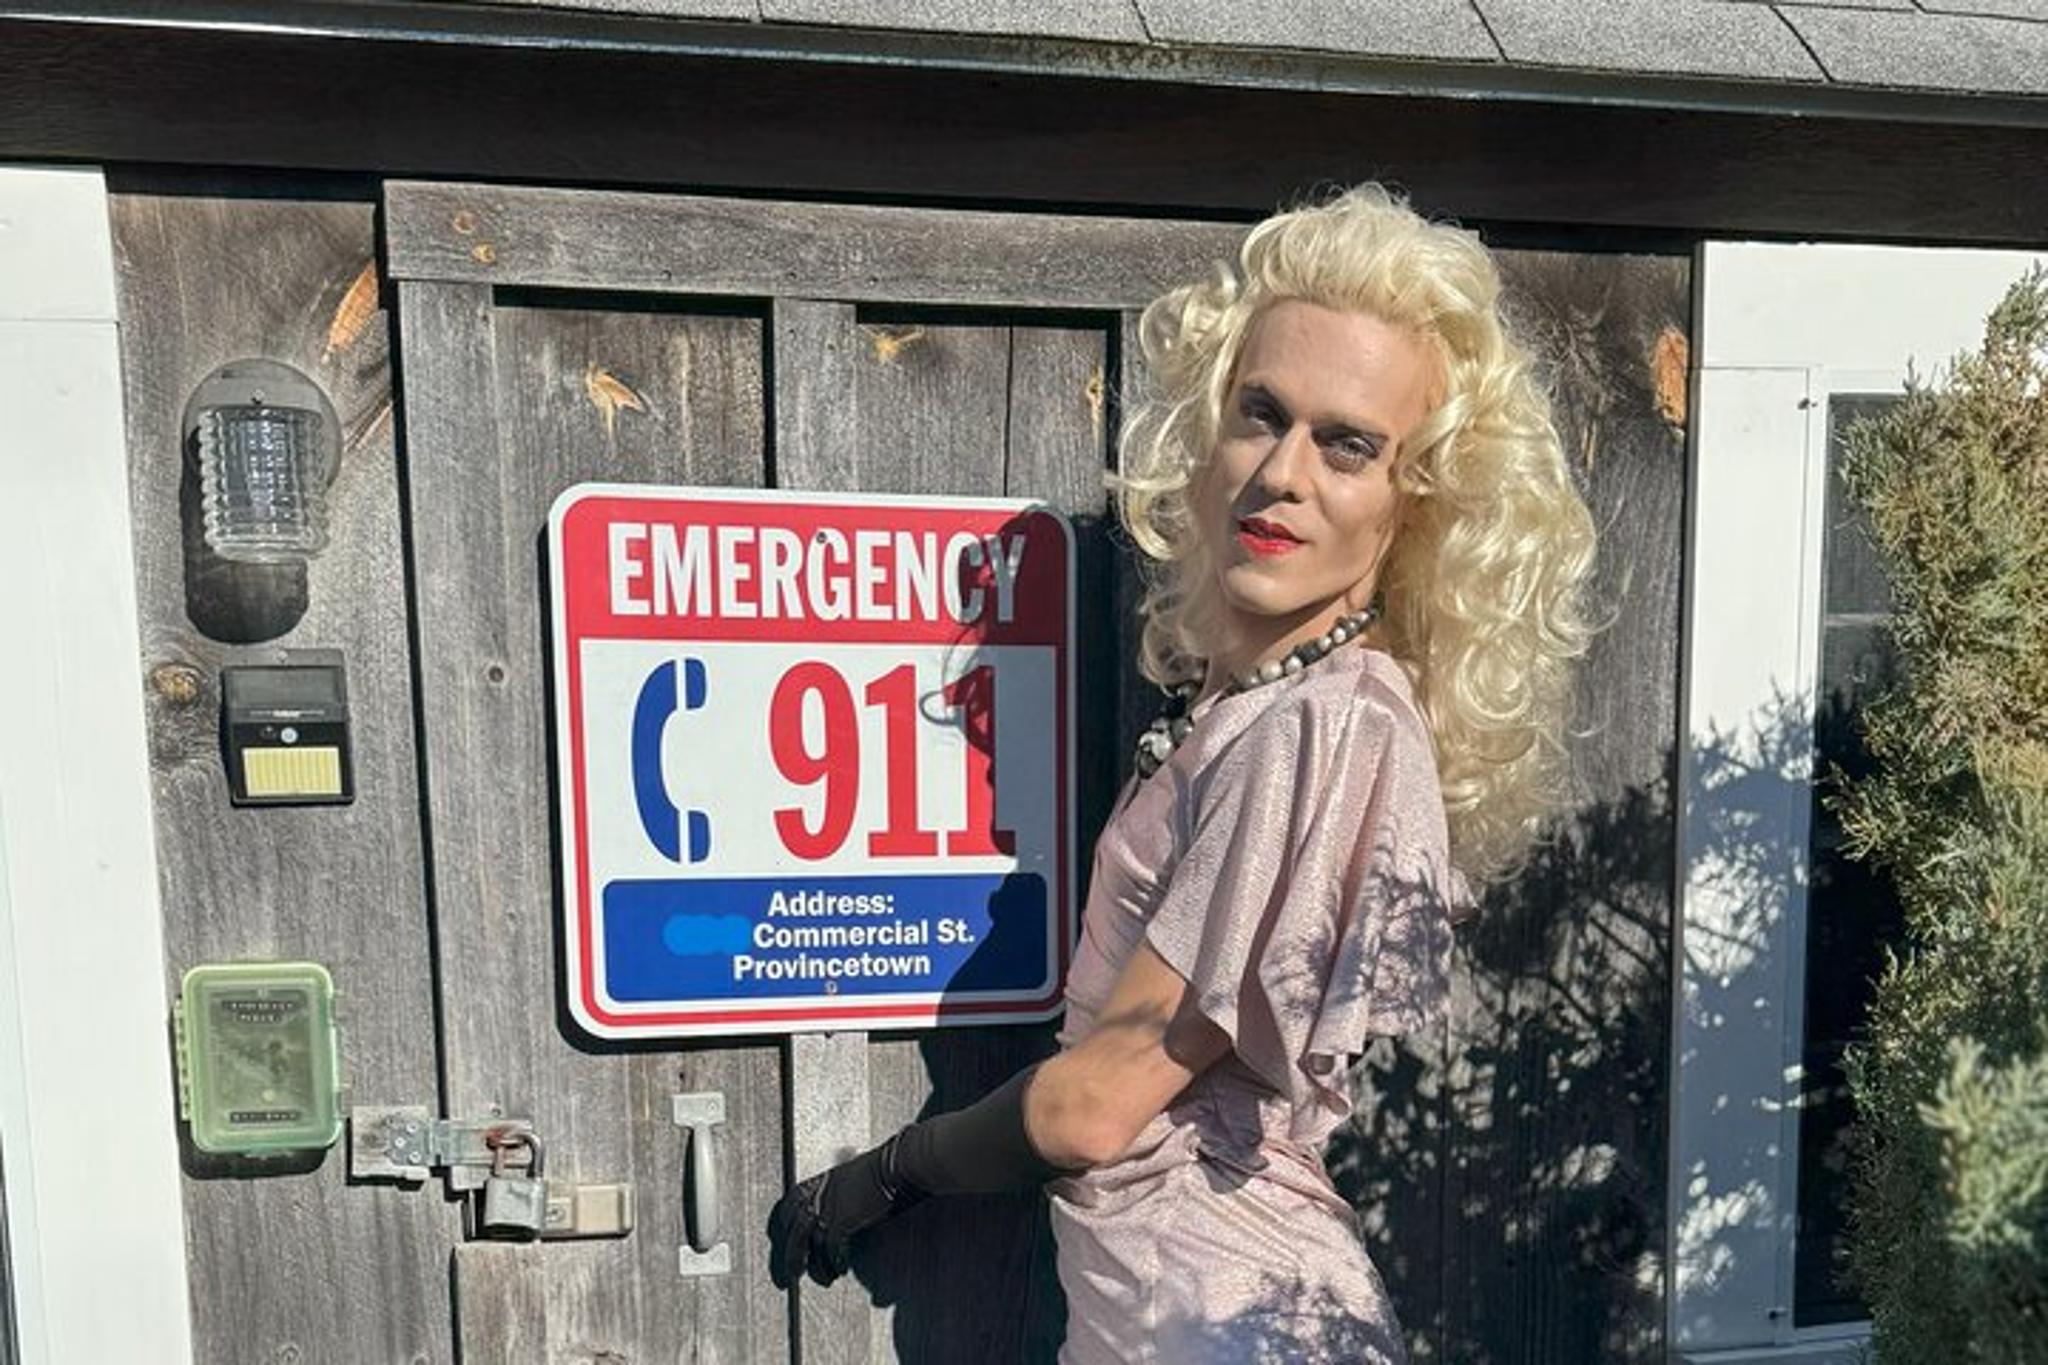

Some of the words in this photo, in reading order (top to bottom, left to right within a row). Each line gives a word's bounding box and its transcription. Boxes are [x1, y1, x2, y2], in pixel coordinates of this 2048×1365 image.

[608, 522, 1026, 624] EMERGENCY
[768, 661, 1017, 860] 911
[767, 891, 895, 917] Address:
[752, 920, 929, 949] Commercial
[936, 919, 976, 944] St.
[732, 953, 931, 981] Provincetown
